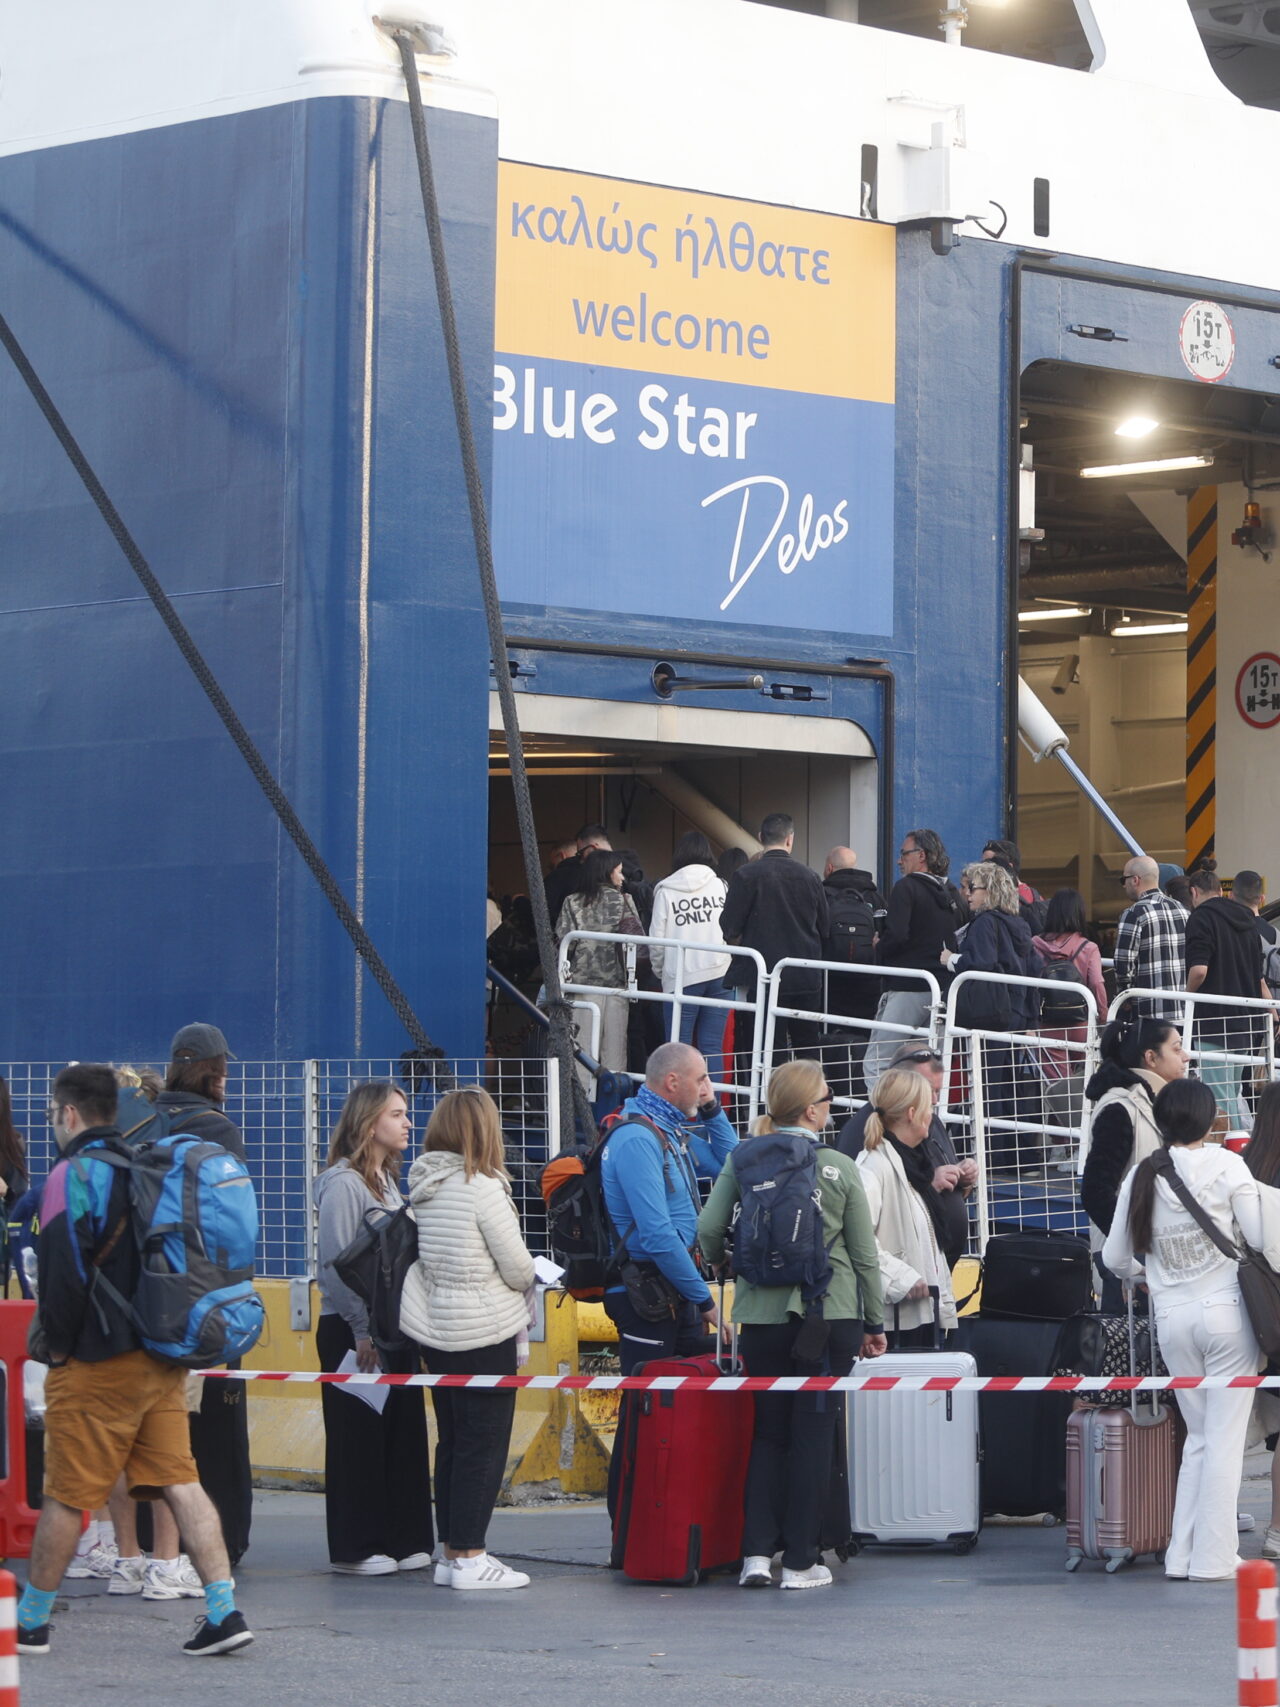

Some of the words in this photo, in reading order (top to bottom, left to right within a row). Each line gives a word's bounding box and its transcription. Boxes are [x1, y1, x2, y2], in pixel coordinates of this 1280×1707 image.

[511, 195, 658, 269] καλώς
[675, 212, 831, 285] ήλθατε
[572, 292, 770, 359] welcome
[493, 364, 619, 444] Blue
[637, 383, 758, 459] Star
[700, 475, 849, 611] Delos
[1250, 664, 1279, 689] 15T
[671, 895, 725, 915] LOCALS
[675, 909, 713, 927] ONLY
